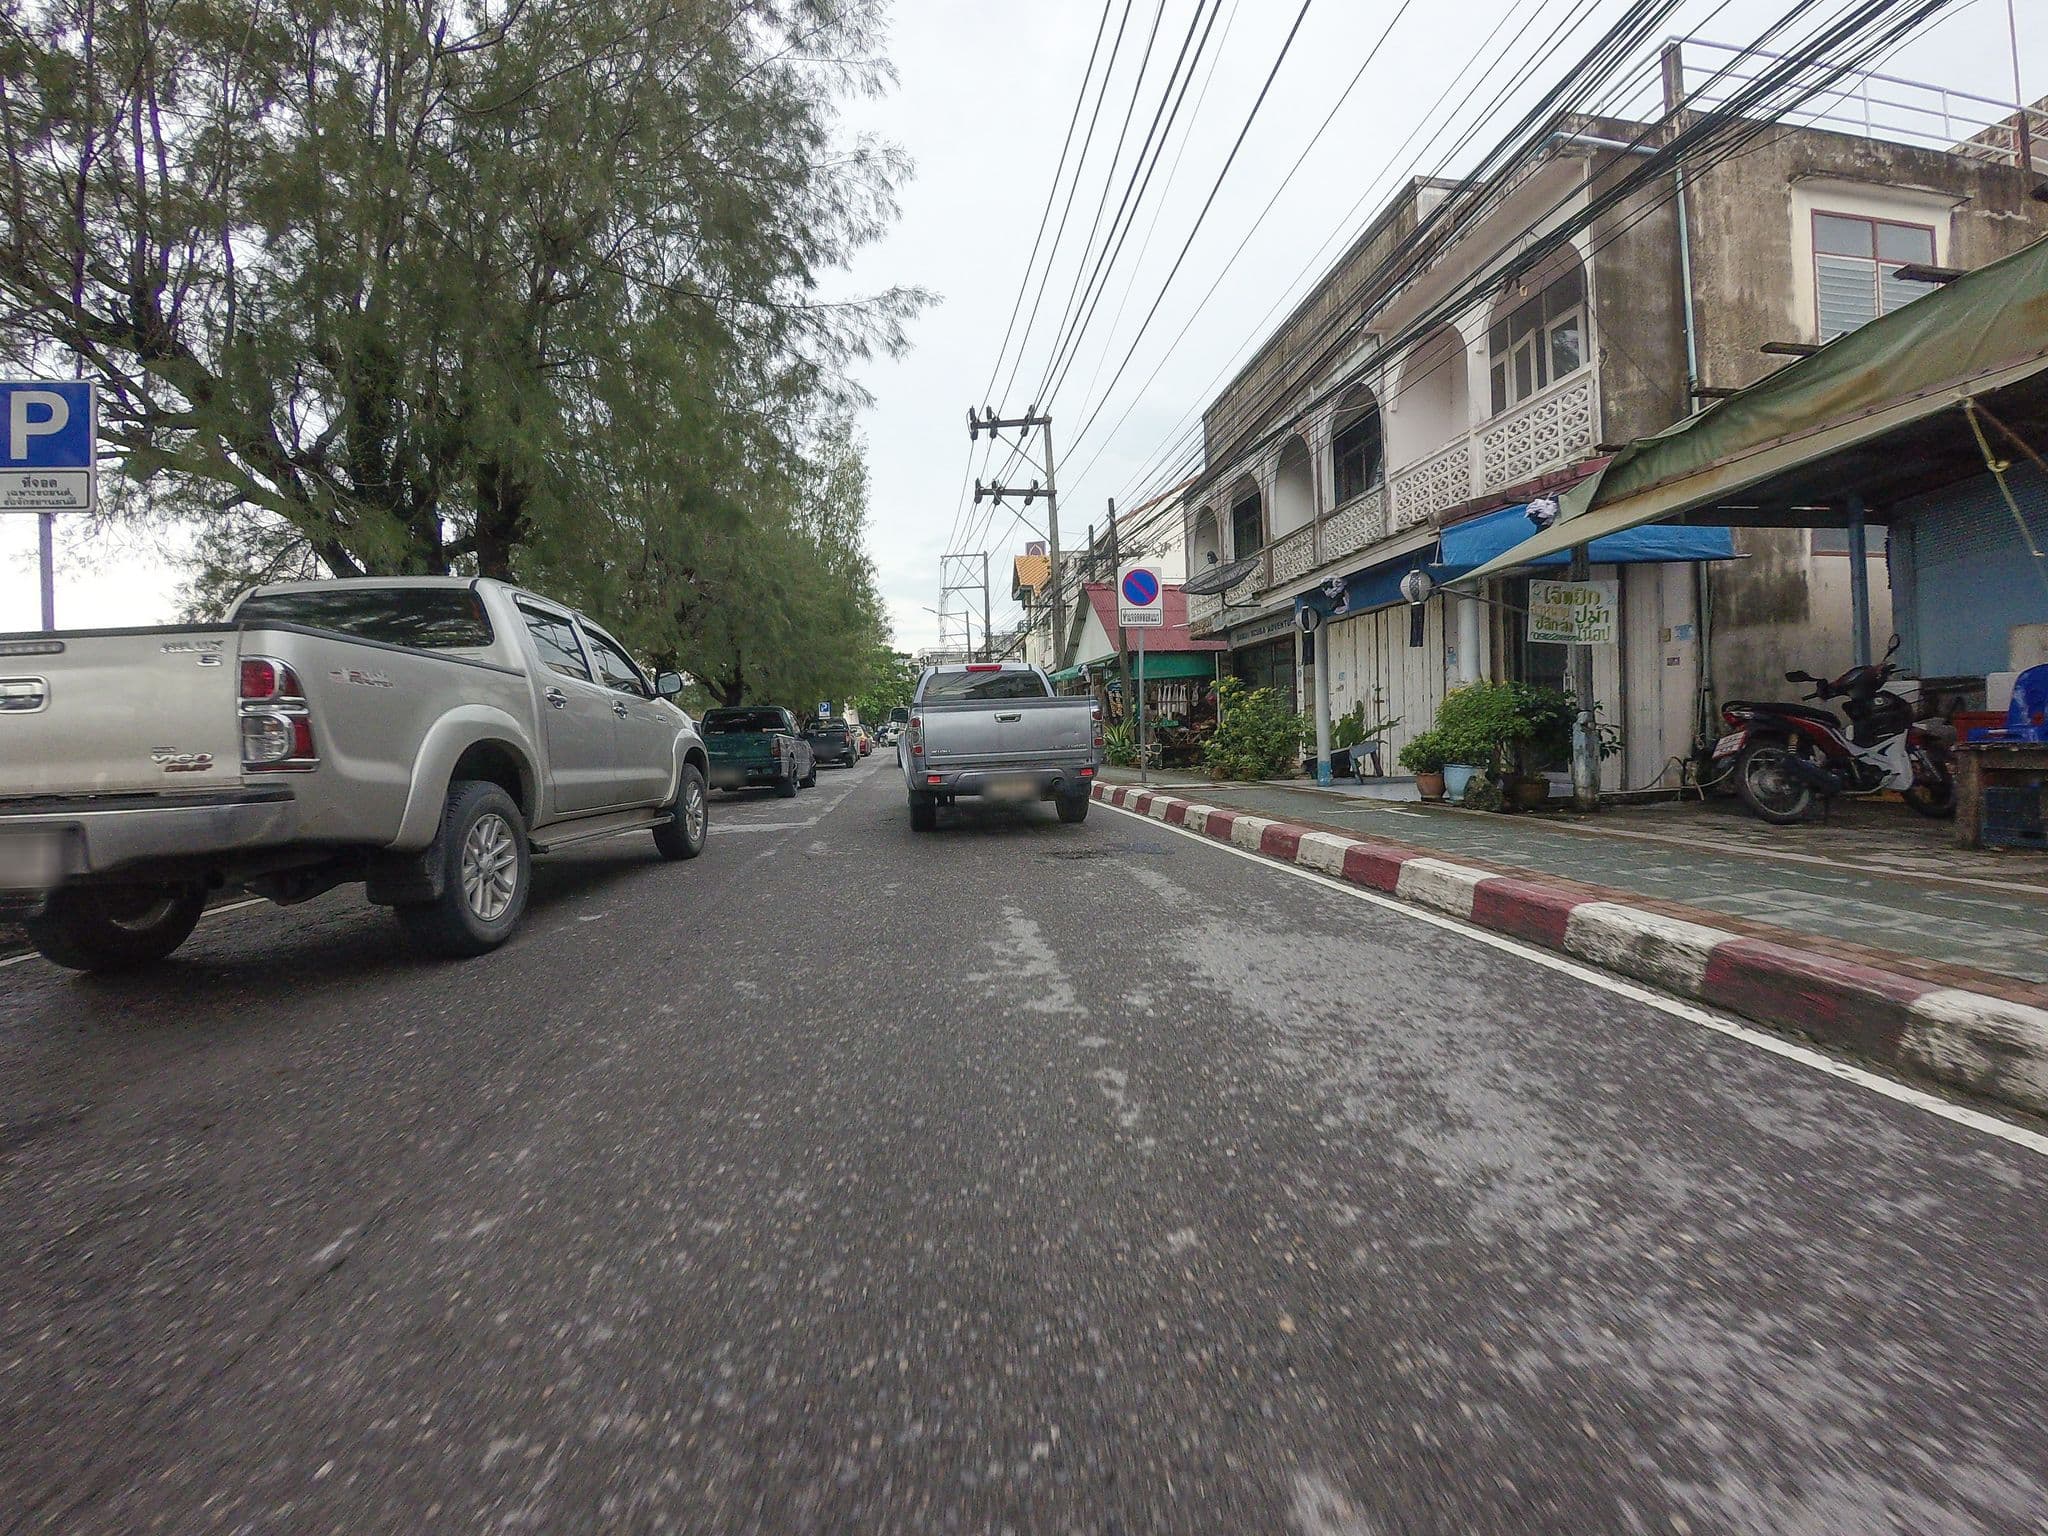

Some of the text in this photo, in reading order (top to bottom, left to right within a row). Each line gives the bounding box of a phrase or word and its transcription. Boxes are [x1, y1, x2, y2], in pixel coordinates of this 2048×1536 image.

[10, 391, 69, 460] P
[21, 473, 58, 488] ที่จอด
[150, 752, 214, 764] VIGO
